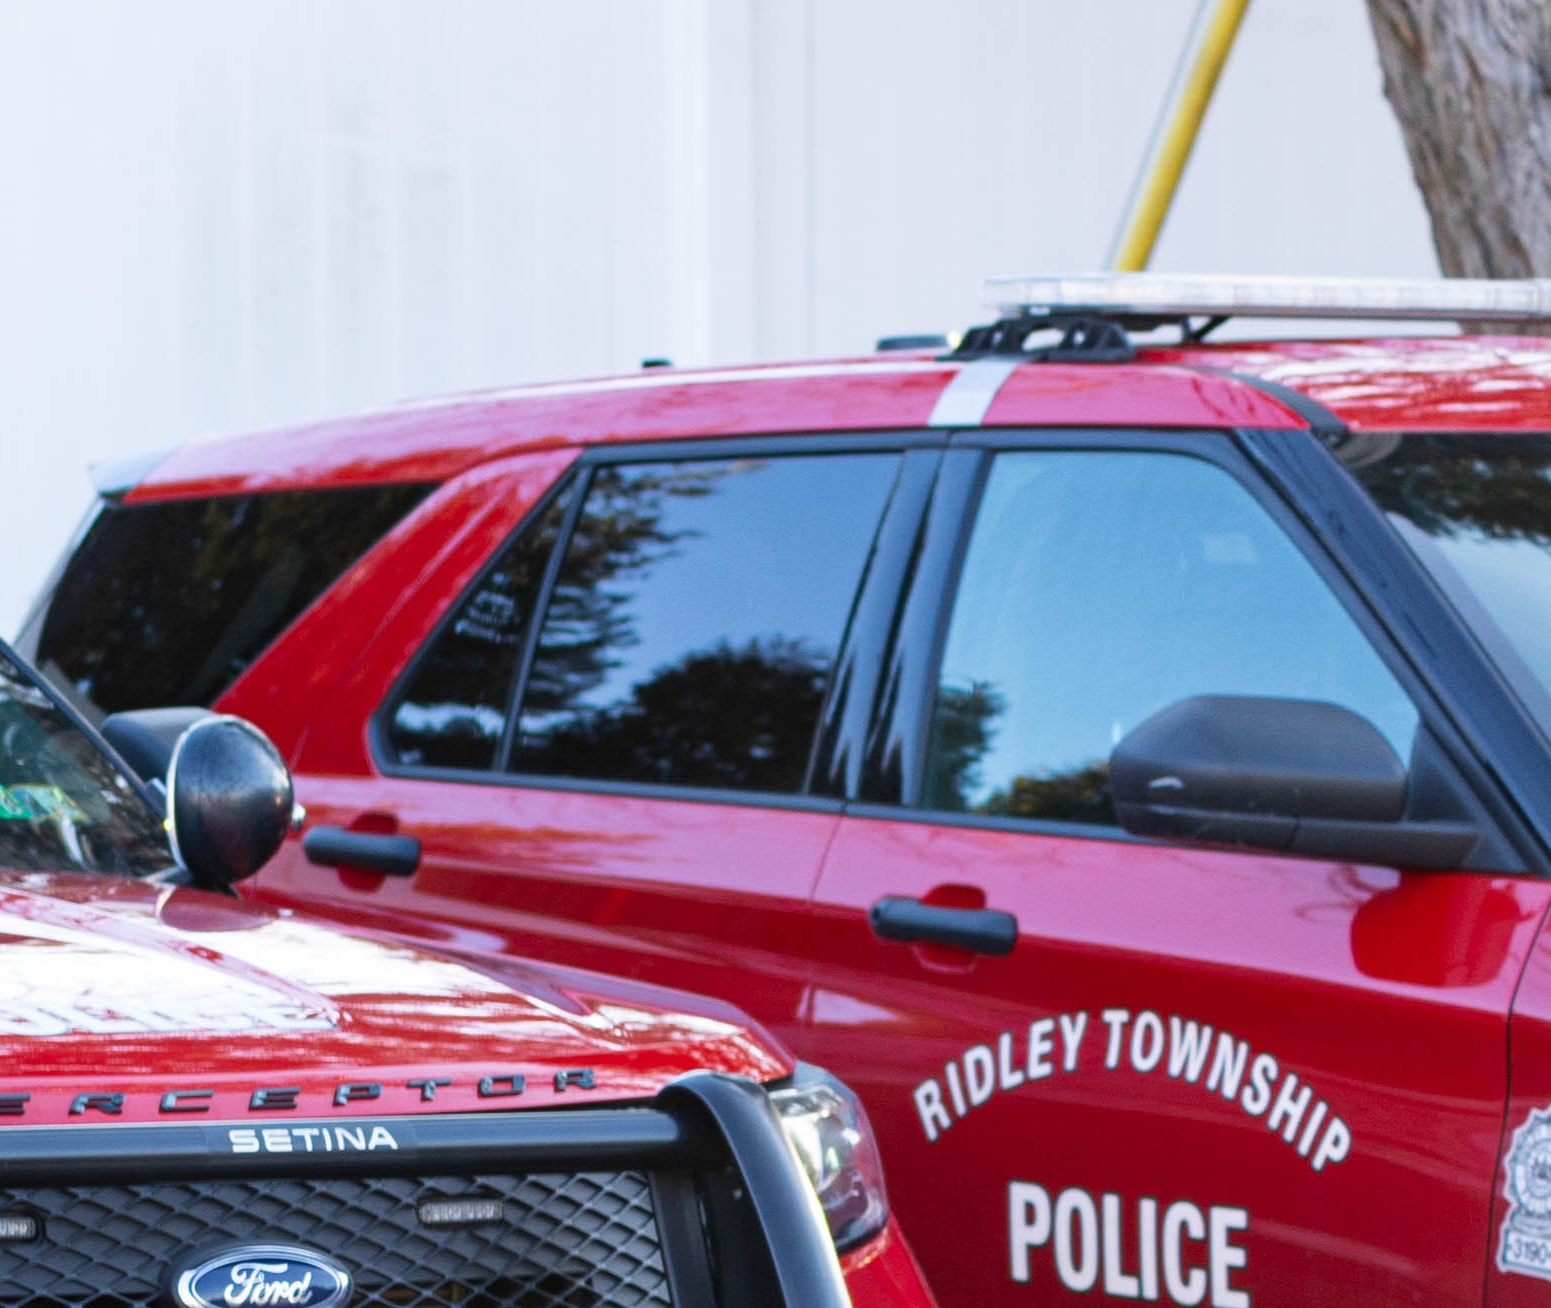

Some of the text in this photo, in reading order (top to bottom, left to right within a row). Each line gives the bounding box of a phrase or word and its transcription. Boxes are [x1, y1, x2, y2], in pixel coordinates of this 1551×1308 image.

[912, 1009, 1088, 1142] RIDLEY
[1101, 1007, 1353, 1173] TOWNSHIP
[228, 1125, 399, 1154] SETINA
[224, 1262, 313, 1307] Ford
